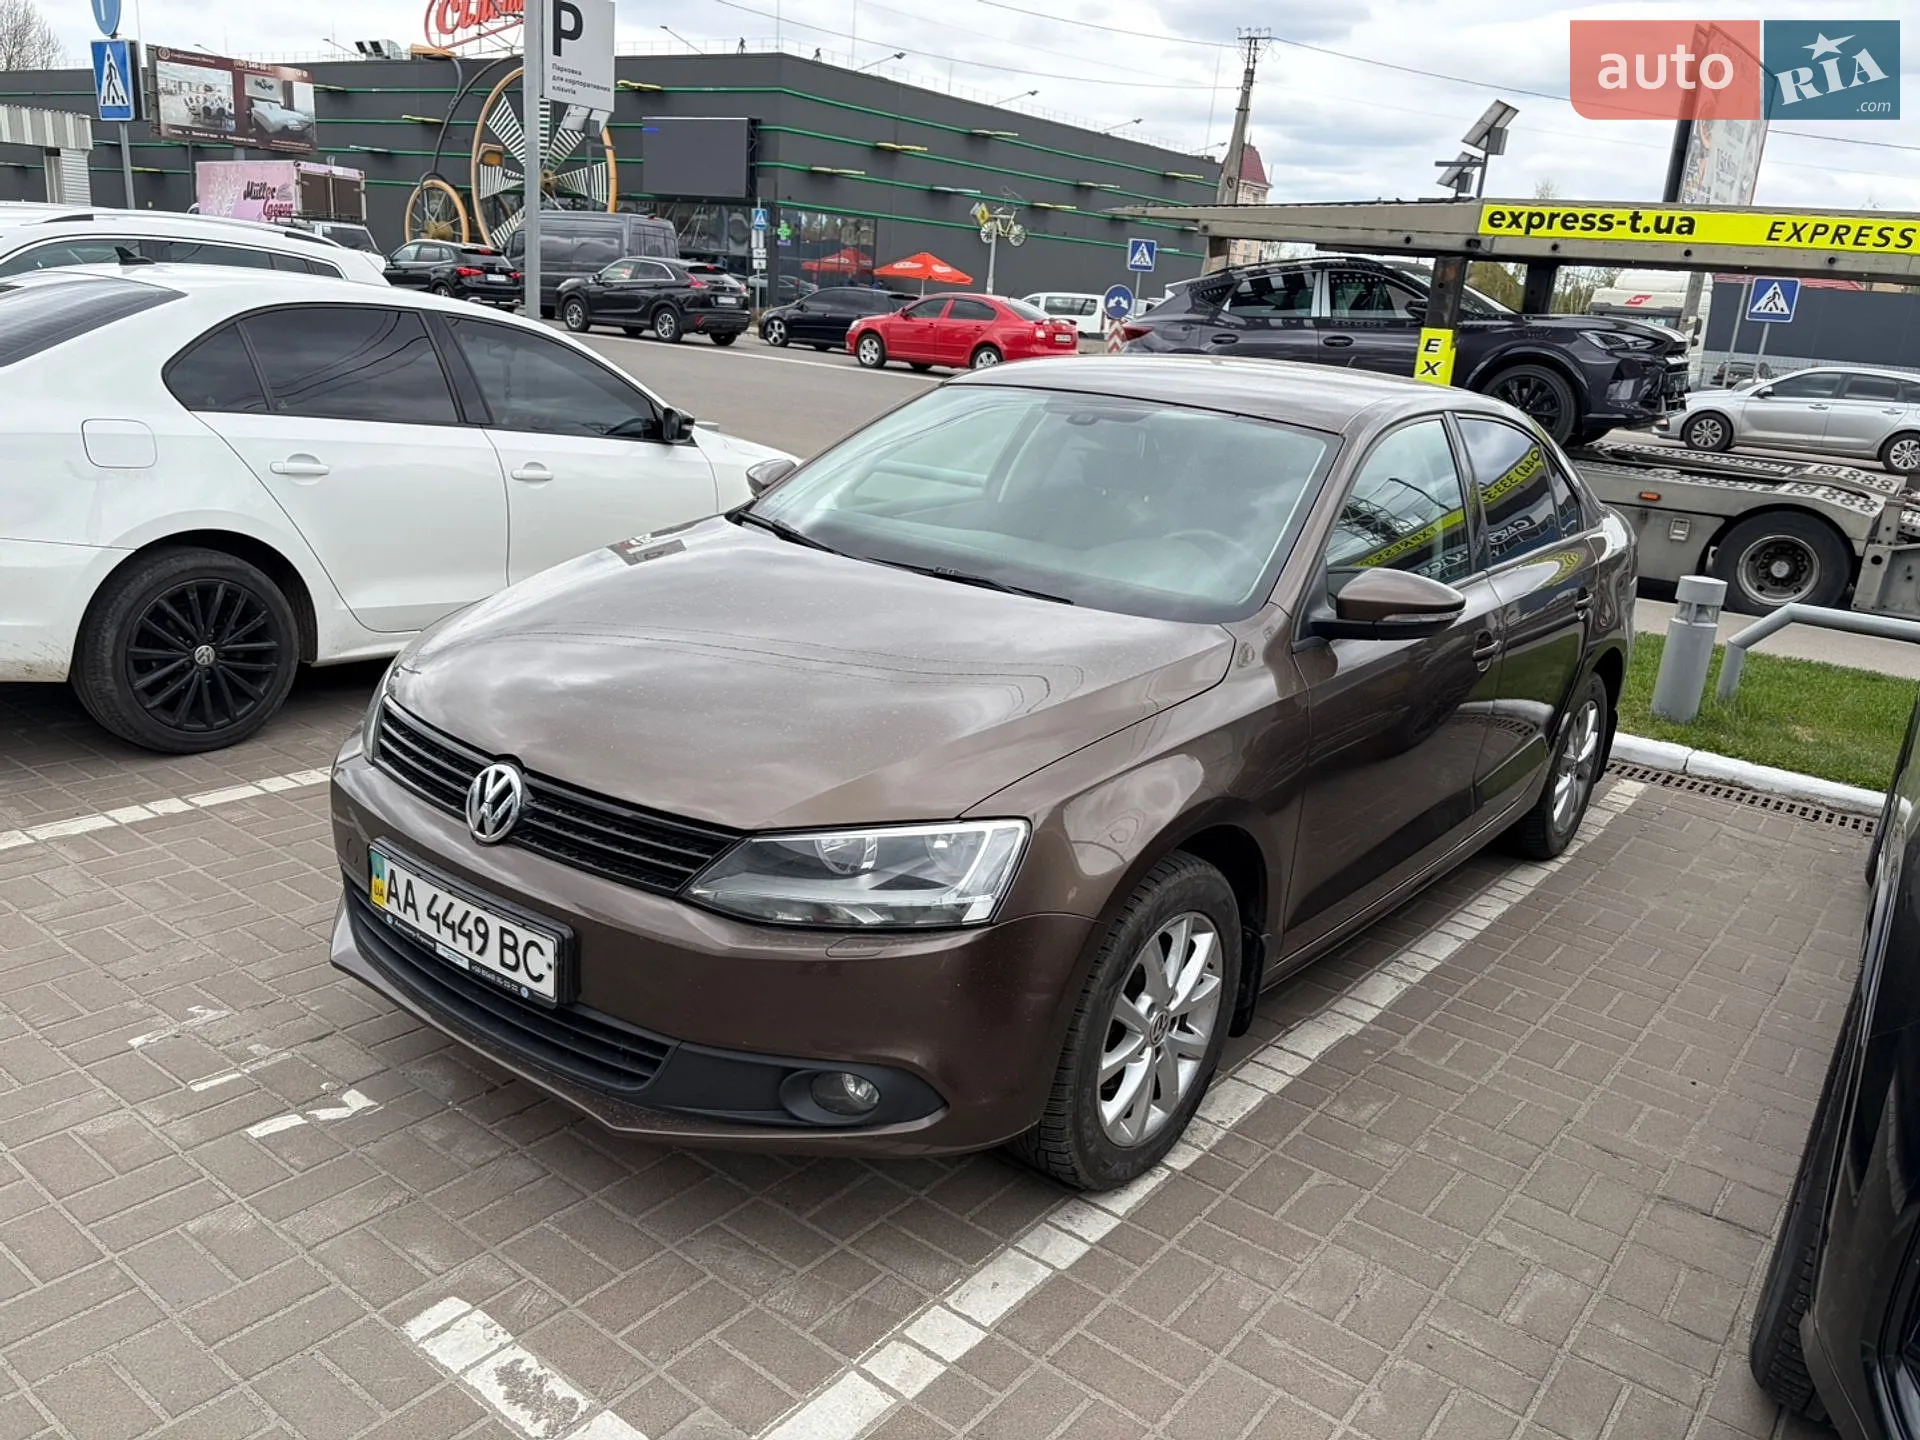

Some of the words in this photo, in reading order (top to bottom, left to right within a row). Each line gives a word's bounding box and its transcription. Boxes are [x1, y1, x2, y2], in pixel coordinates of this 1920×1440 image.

[552, 0, 583, 57] P
[552, 62, 582, 76] Парковка
[552, 75, 564, 83] для
[1487, 208, 1696, 236] express-t.ua
[1766, 220, 1918, 250] EXPRESS
[373, 886, 384, 898] UA
[386, 868, 420, 923] AA
[426, 893, 490, 957] 4449
[499, 925, 546, 983] BC
